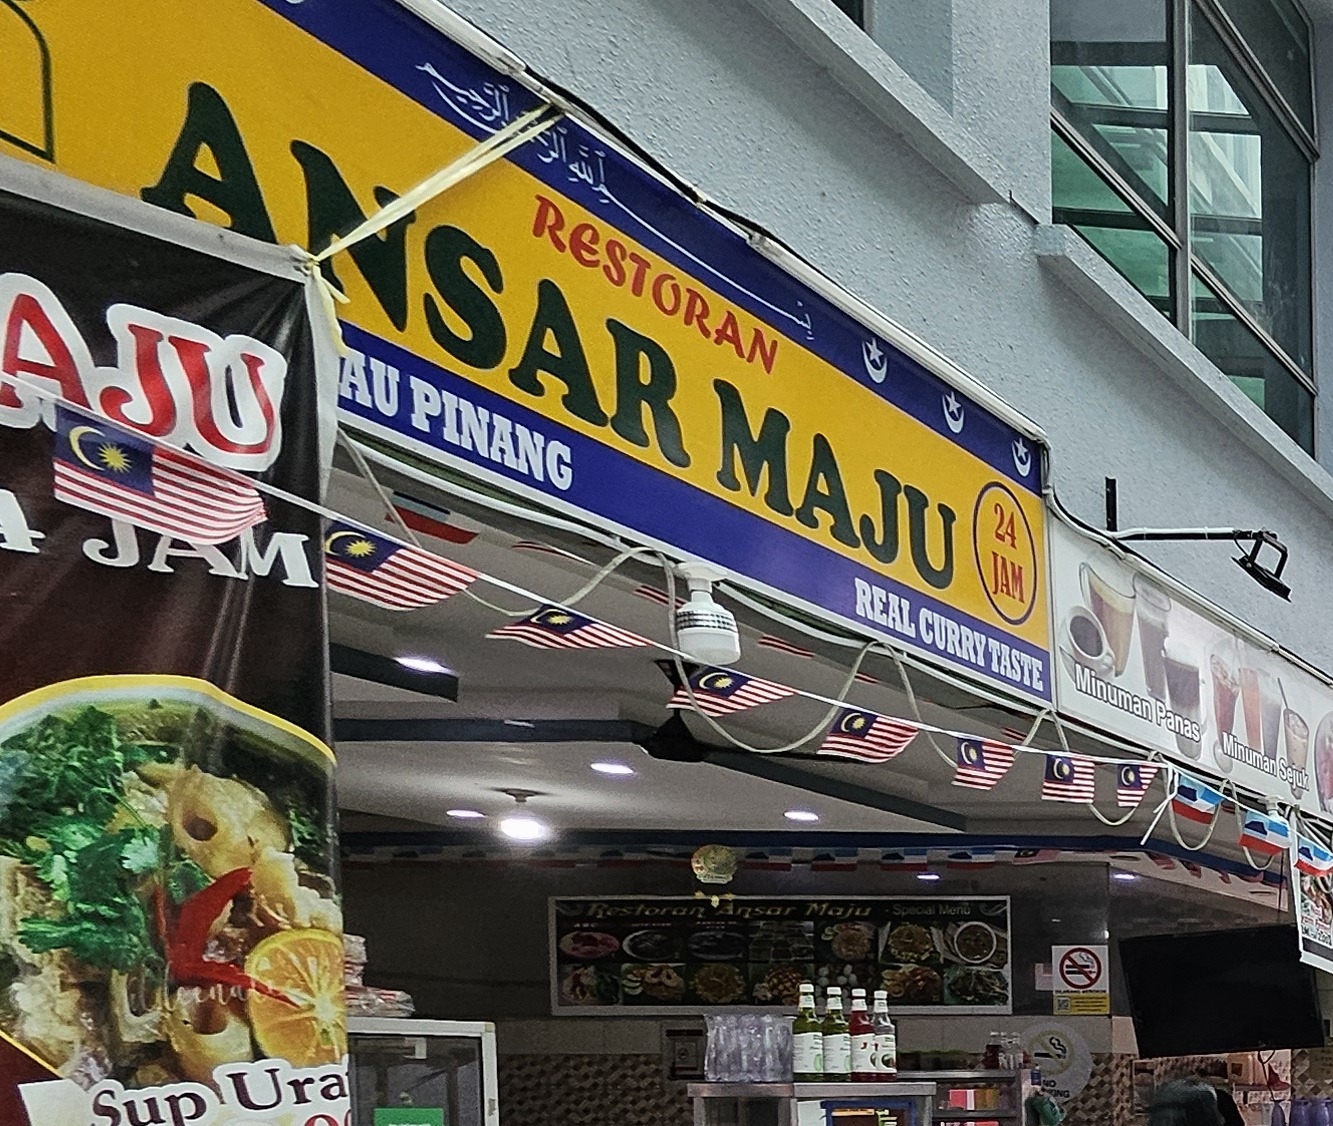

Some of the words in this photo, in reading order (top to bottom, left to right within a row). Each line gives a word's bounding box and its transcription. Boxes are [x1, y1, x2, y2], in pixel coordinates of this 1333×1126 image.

[534, 194, 779, 374] RESTORAN
[141, 81, 691, 468] ANSAR
[714, 380, 956, 590] MAJU
[410, 375, 573, 491] PINANG
[82, 516, 320, 588] JAM
[993, 502, 1017, 550] 24
[991, 550, 1025, 605] JAM
[855, 577, 916, 639] REAL
[919, 607, 987, 668] CURRY
[988, 637, 1044, 692] TASTE
[1074, 662, 1153, 722] Minuman
[1155, 700, 1201, 743] Panas
[1222, 731, 1278, 778] Minuman
[1277, 756, 1310, 793] Sejuk
[805, 902, 873, 920] Maju
[892, 903, 936, 917] Special
[938, 903, 971, 916] Menu
[226, 1067, 350, 1112] Ura
